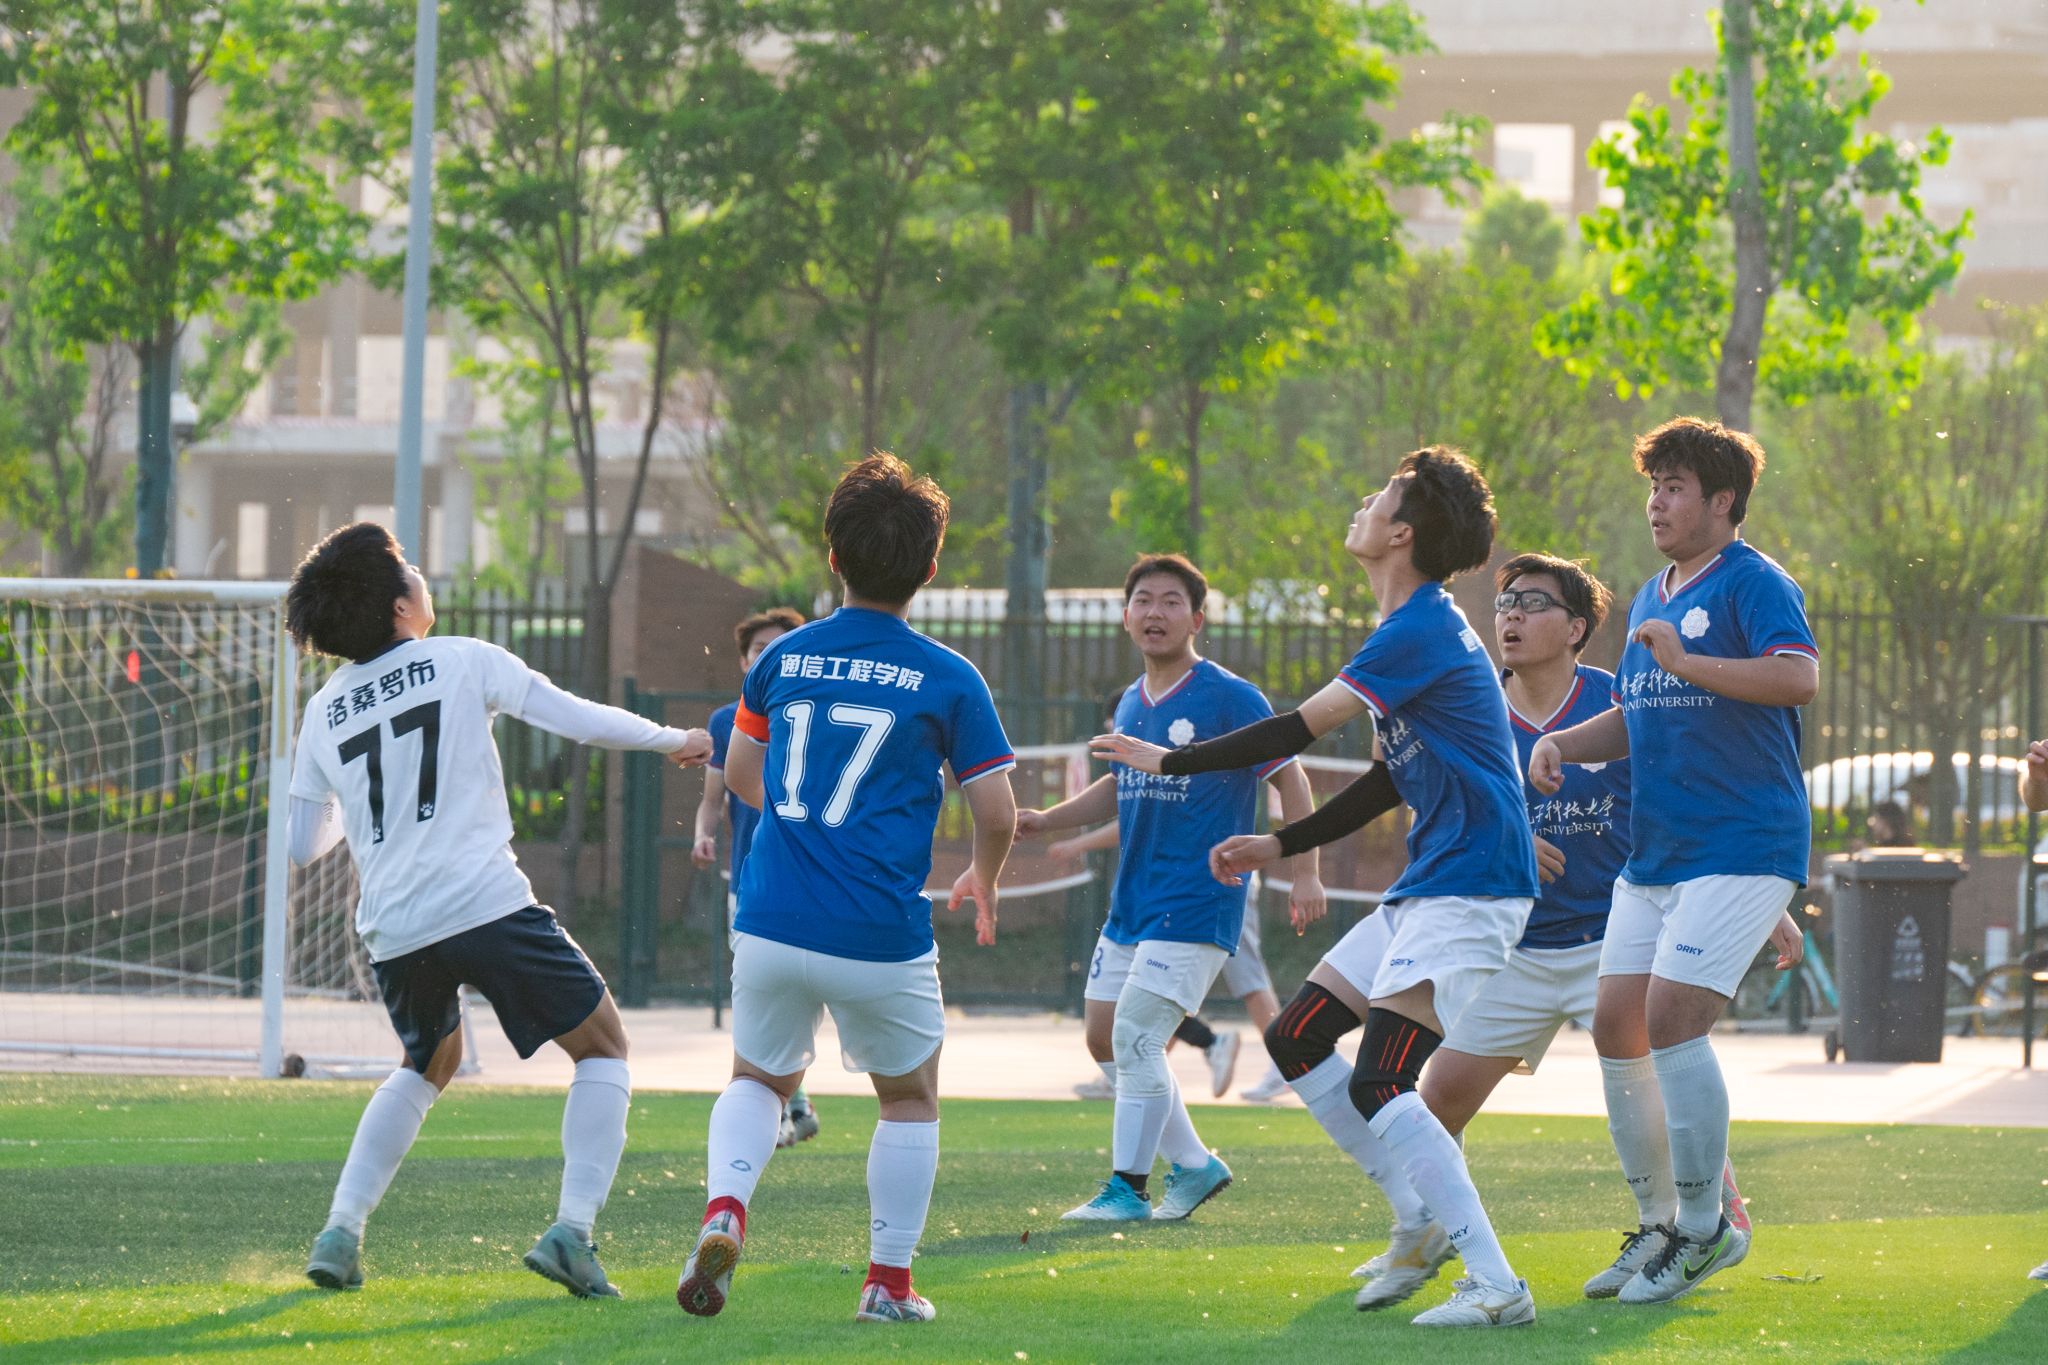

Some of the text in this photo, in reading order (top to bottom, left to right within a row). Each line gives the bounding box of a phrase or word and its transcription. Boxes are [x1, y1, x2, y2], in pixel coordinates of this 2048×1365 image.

[327, 658, 436, 730] 洛桑罗布
[780, 654, 925, 691] 通信工程学院
[337, 699, 441, 845] 77
[773, 700, 896, 828] 17
[1676, 944, 1704, 956] ORKY
[1449, 1225, 1469, 1241] RKY
